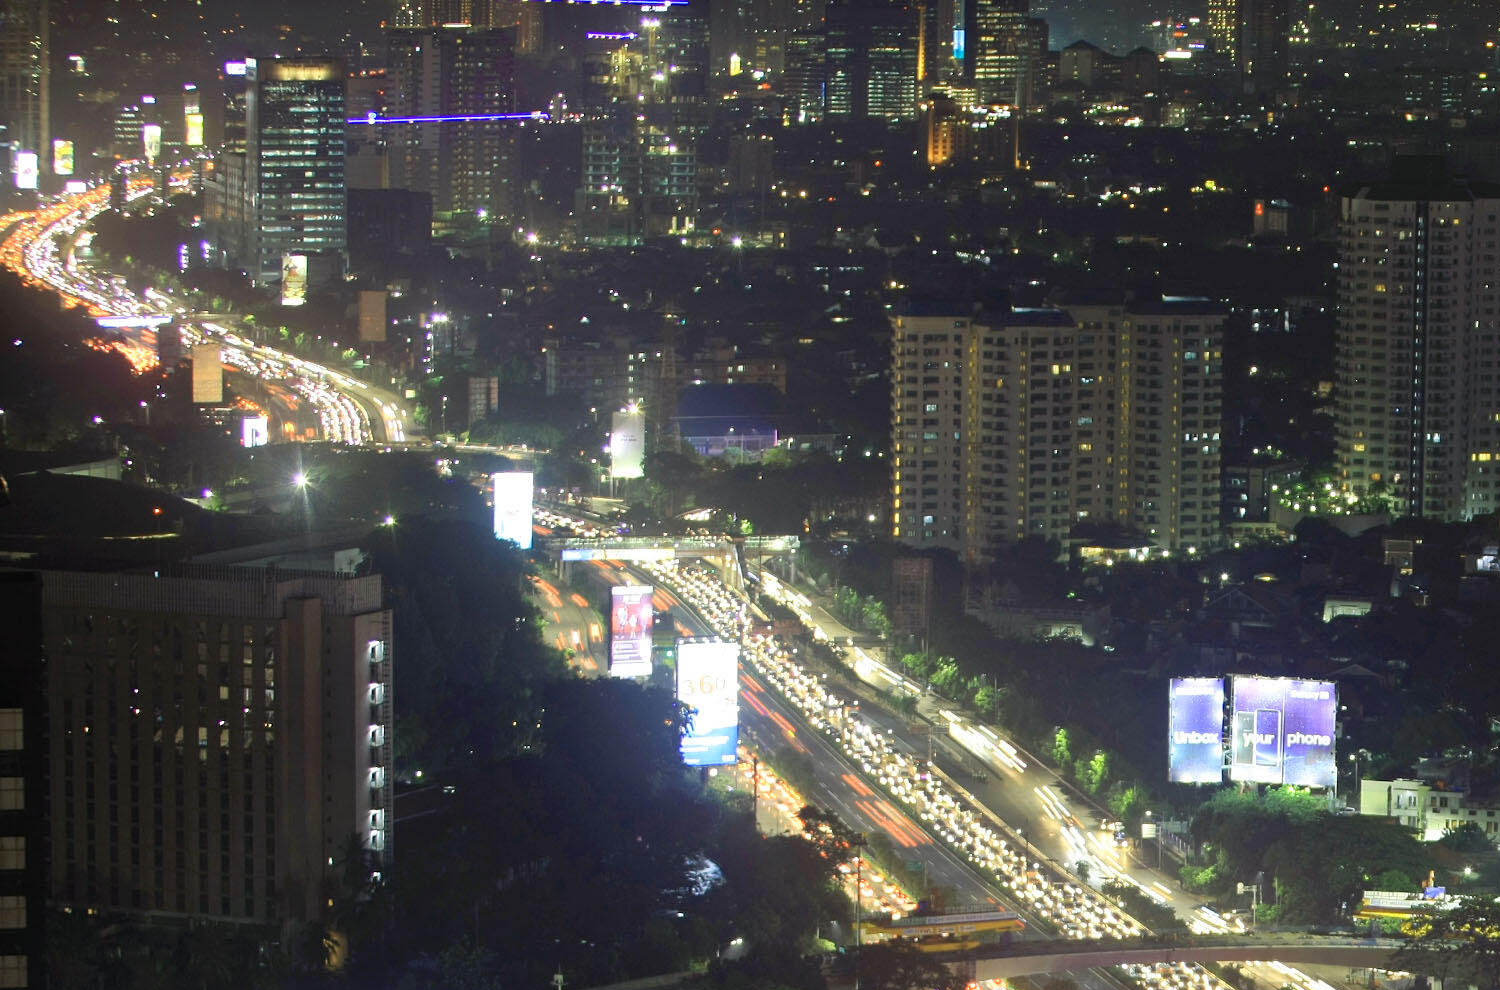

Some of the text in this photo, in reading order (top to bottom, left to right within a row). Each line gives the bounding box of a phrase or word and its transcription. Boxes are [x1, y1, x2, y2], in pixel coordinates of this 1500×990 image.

[1174, 730, 1331, 747] Unbox your phone
